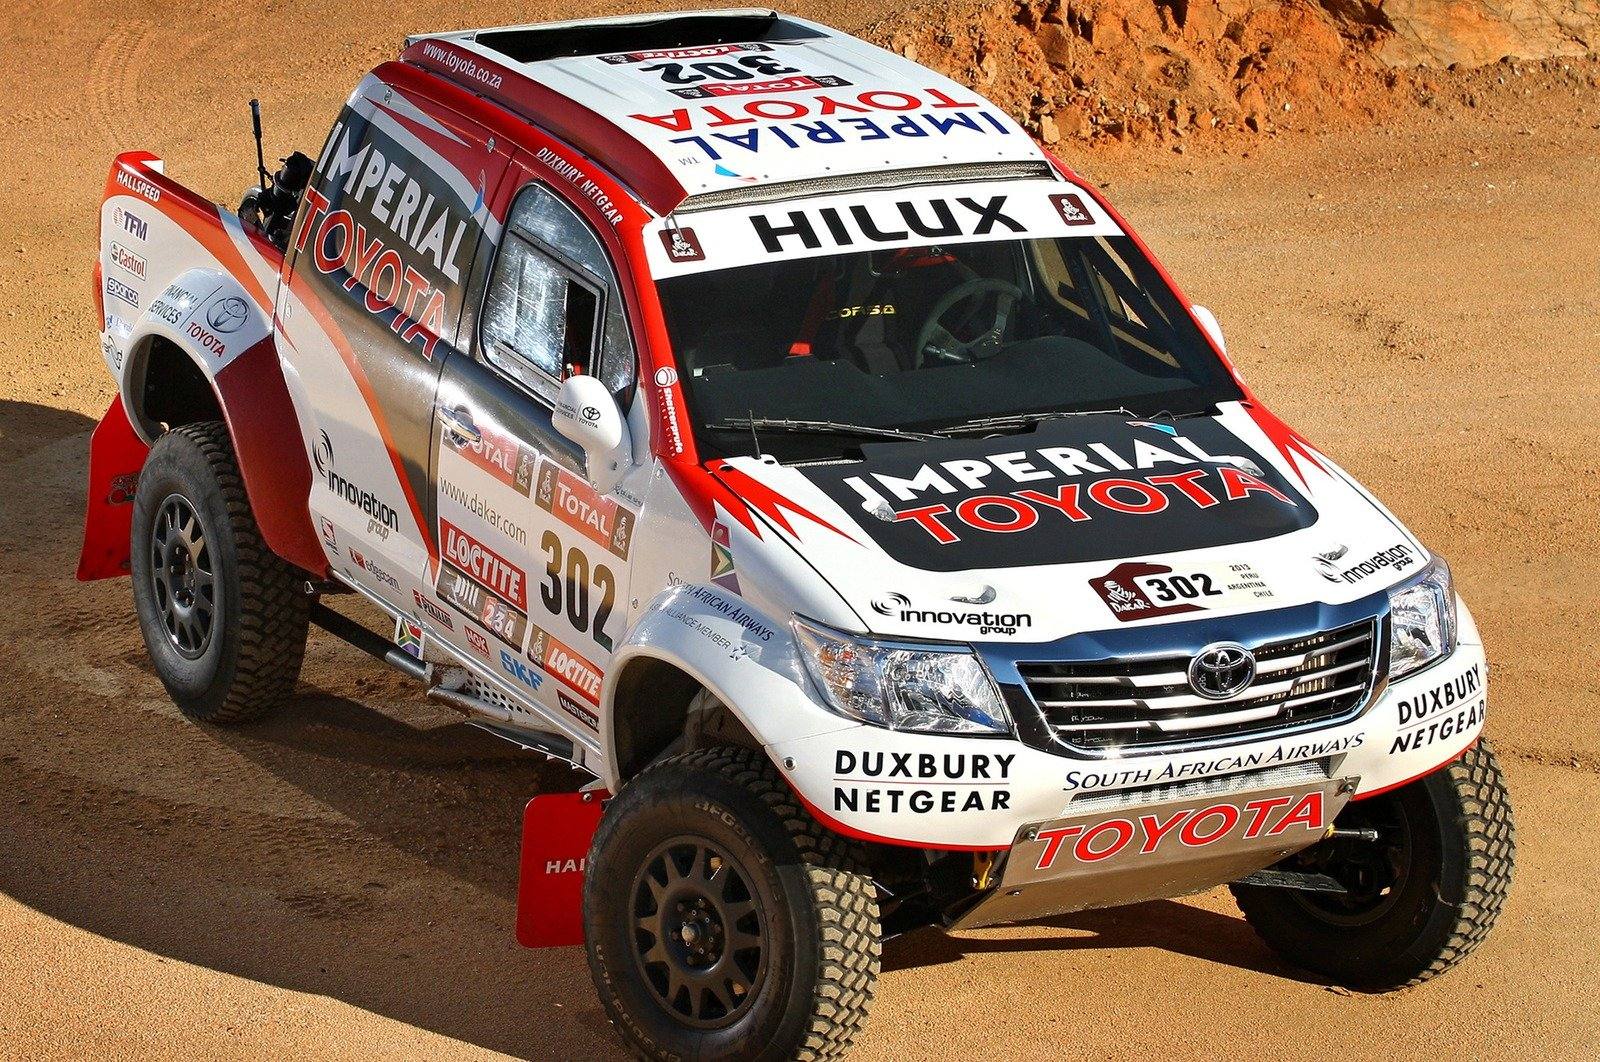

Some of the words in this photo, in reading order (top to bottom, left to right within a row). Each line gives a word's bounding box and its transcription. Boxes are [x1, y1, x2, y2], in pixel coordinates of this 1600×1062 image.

[423, 42, 503, 90] www.toyota.co.za
[638, 46, 730, 60] LOCTITE
[638, 56, 801, 84] 302
[708, 77, 811, 92] TOTAL
[629, 89, 979, 133] TOYOTA
[670, 110, 1010, 161] IMPERIAL
[117, 170, 161, 202] HALLSPEED
[317, 121, 469, 285] IMPERIAL
[537, 147, 586, 183] DUXBURY
[581, 179, 624, 226] NETGEAR
[124, 210, 148, 241] TFM
[749, 195, 1028, 254] HILUX
[119, 248, 145, 277] Castrol
[295, 188, 447, 361] TOYOTA
[186, 322, 227, 358] TOYOTA
[578, 418, 599, 429] TOYOTA
[662, 387, 684, 453] Shatterprufe
[469, 440, 514, 476] OTAL
[843, 436, 1242, 506] IMPERIAL
[327, 469, 399, 532] innovation
[440, 476, 528, 547] www.dakar.com
[556, 481, 611, 538] TOTAL
[894, 465, 1298, 546] TOYOTA
[446, 528, 521, 603] LOCTITE
[1227, 581, 1267, 590] ARGENTINA
[1229, 563, 1251, 572] 2013
[1340, 544, 1413, 584] innovation
[540, 529, 615, 653] 302
[1110, 599, 1150, 613] DAKAR
[1146, 573, 1223, 602] 302
[1253, 590, 1274, 598] CHILE
[692, 586, 732, 615] AFRICAN
[728, 606, 775, 642] AIRWAYS
[900, 607, 1032, 628] innovation
[980, 624, 1016, 635] group
[695, 623, 732, 650] MEMBER
[499, 649, 543, 691] SKF
[548, 648, 603, 696] LOCTITE
[1397, 663, 1481, 725] DUXBURY
[1389, 699, 1485, 755] NETGEAR
[835, 750, 1016, 780] DUXBURY
[1063, 769, 1153, 793] SOUTH
[1155, 752, 1262, 781] AFRICAN
[1264, 732, 1364, 763] AIRWAYS
[835, 787, 1012, 813] NETGEAR
[1033, 791, 1327, 870] TOYOTA
